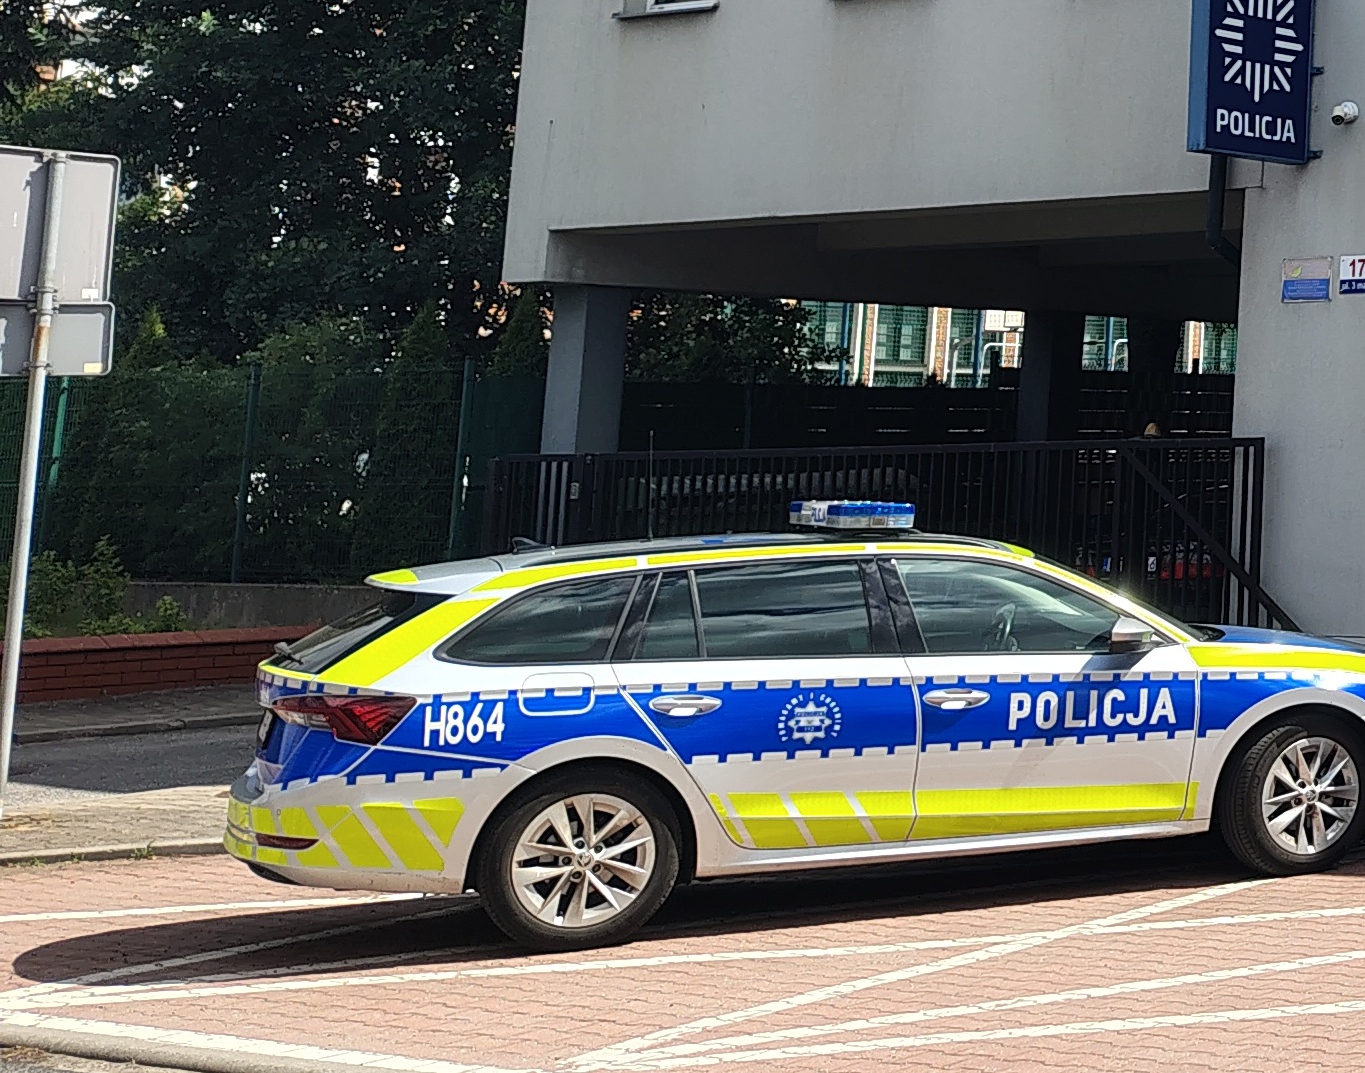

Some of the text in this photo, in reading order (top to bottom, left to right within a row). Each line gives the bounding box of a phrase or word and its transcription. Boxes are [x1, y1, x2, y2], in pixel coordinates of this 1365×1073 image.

[1215, 108, 1296, 144] POLICJA
[423, 701, 506, 748] H864
[1007, 687, 1177, 731] POLICJA
